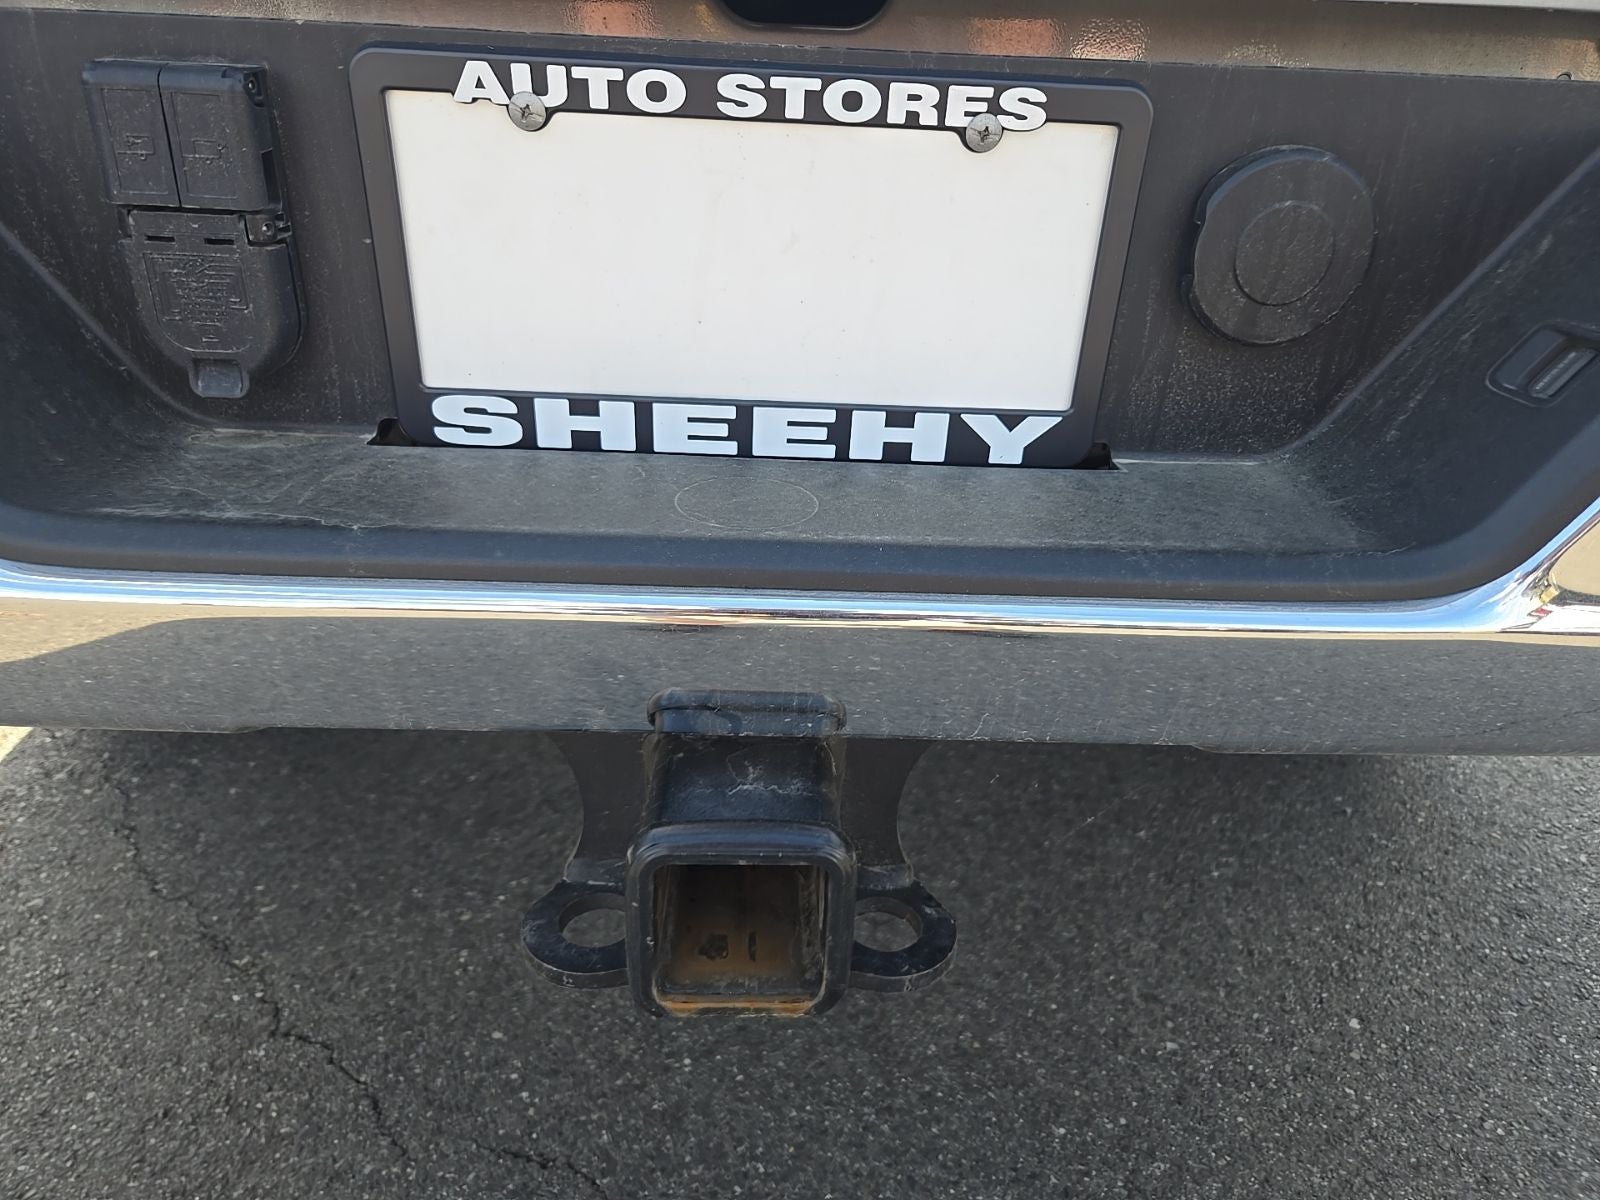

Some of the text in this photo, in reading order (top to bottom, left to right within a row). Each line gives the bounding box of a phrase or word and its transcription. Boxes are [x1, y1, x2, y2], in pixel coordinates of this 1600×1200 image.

[453, 60, 1048, 131] AUTO STORES
[431, 395, 1063, 465] SHEEHY
